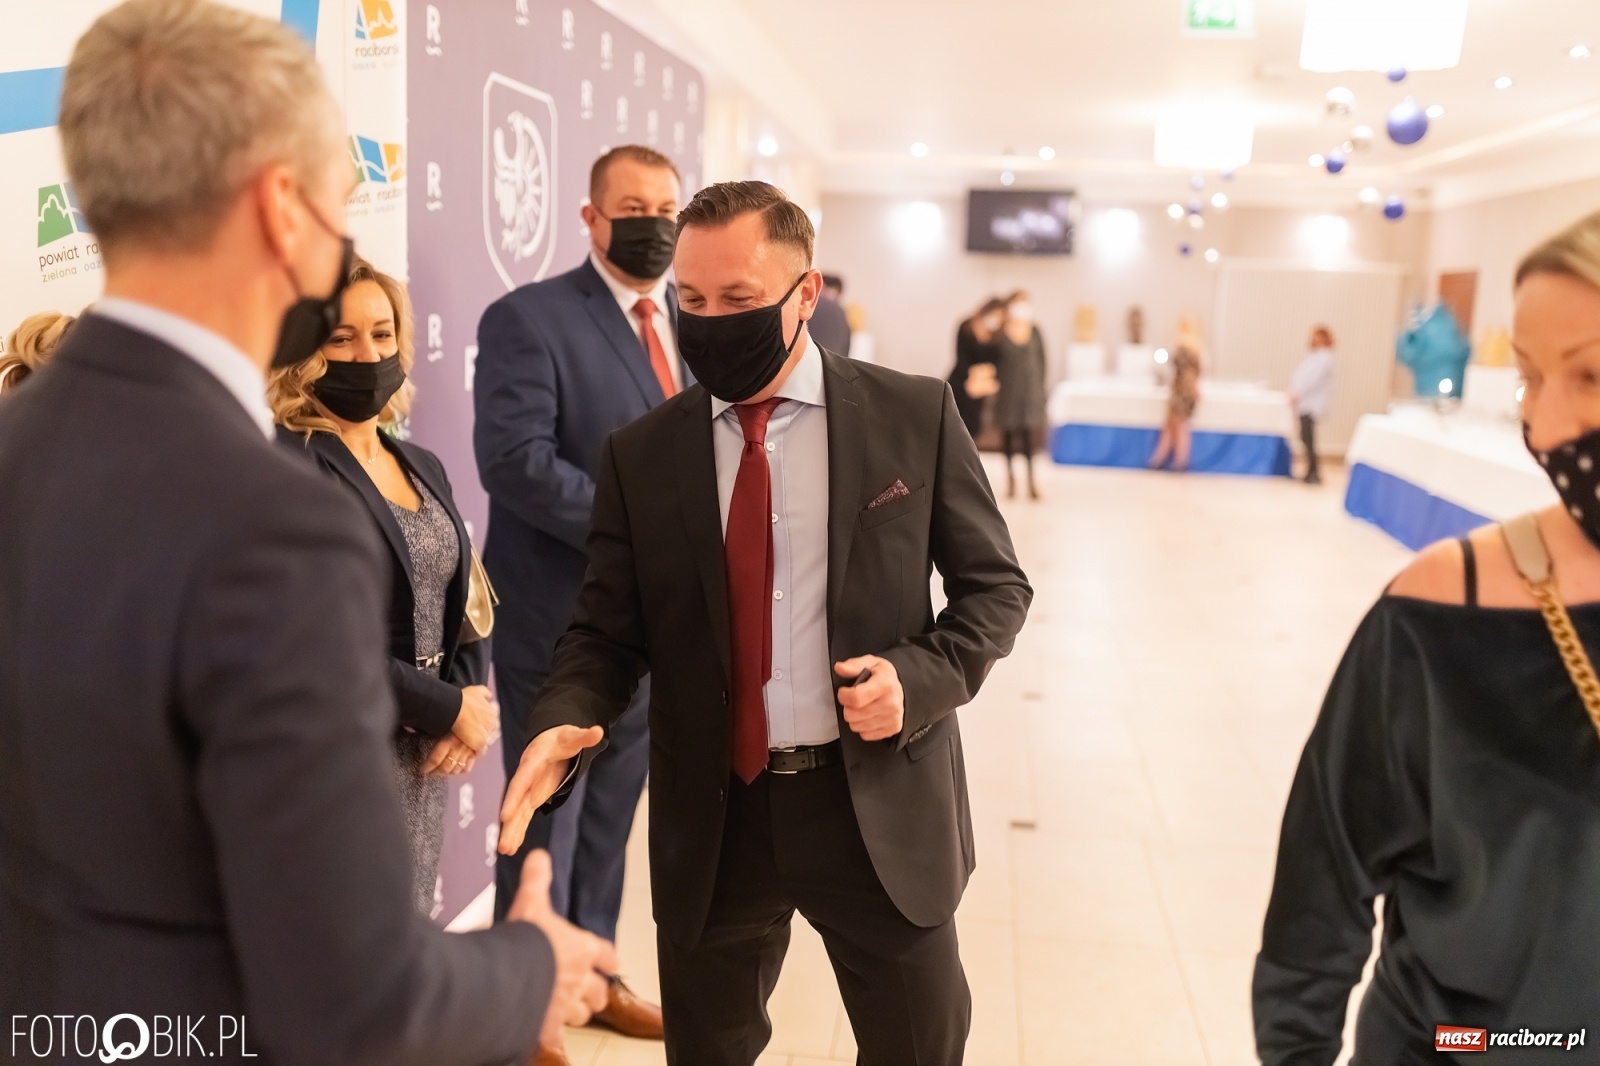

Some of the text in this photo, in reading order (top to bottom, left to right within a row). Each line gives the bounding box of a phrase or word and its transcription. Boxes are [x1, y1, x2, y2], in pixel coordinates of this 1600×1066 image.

[426, 4, 441, 44] R
[427, 161, 441, 199] R
[39, 245, 79, 272] powiat
[42, 266, 77, 283] zielona
[427, 313, 442, 349] R
